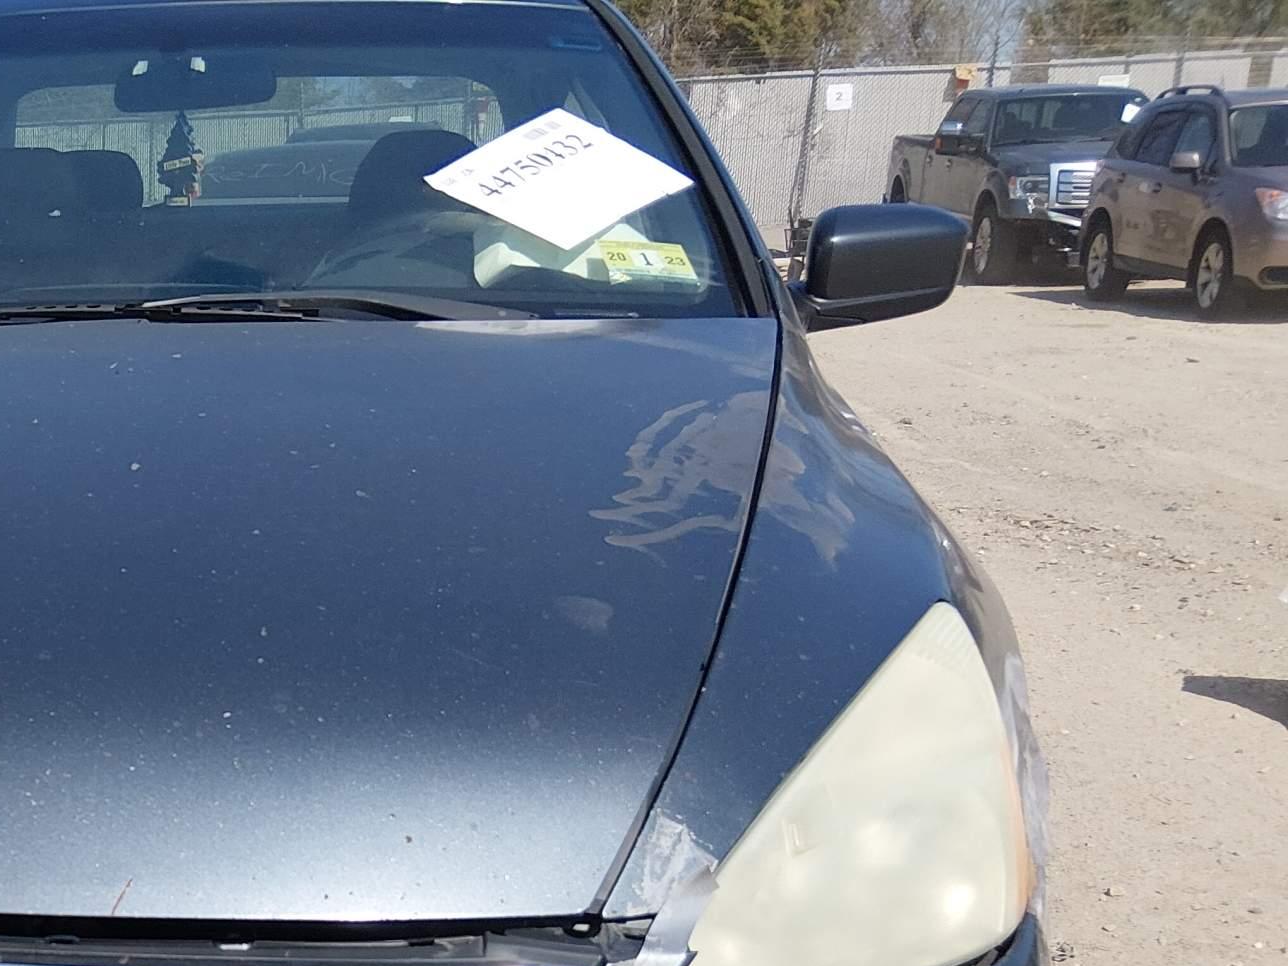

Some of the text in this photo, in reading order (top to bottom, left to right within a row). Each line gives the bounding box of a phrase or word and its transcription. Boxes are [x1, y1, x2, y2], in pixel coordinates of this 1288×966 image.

[835, 91, 844, 102] 2
[606, 251, 686, 266] 20 1 23
